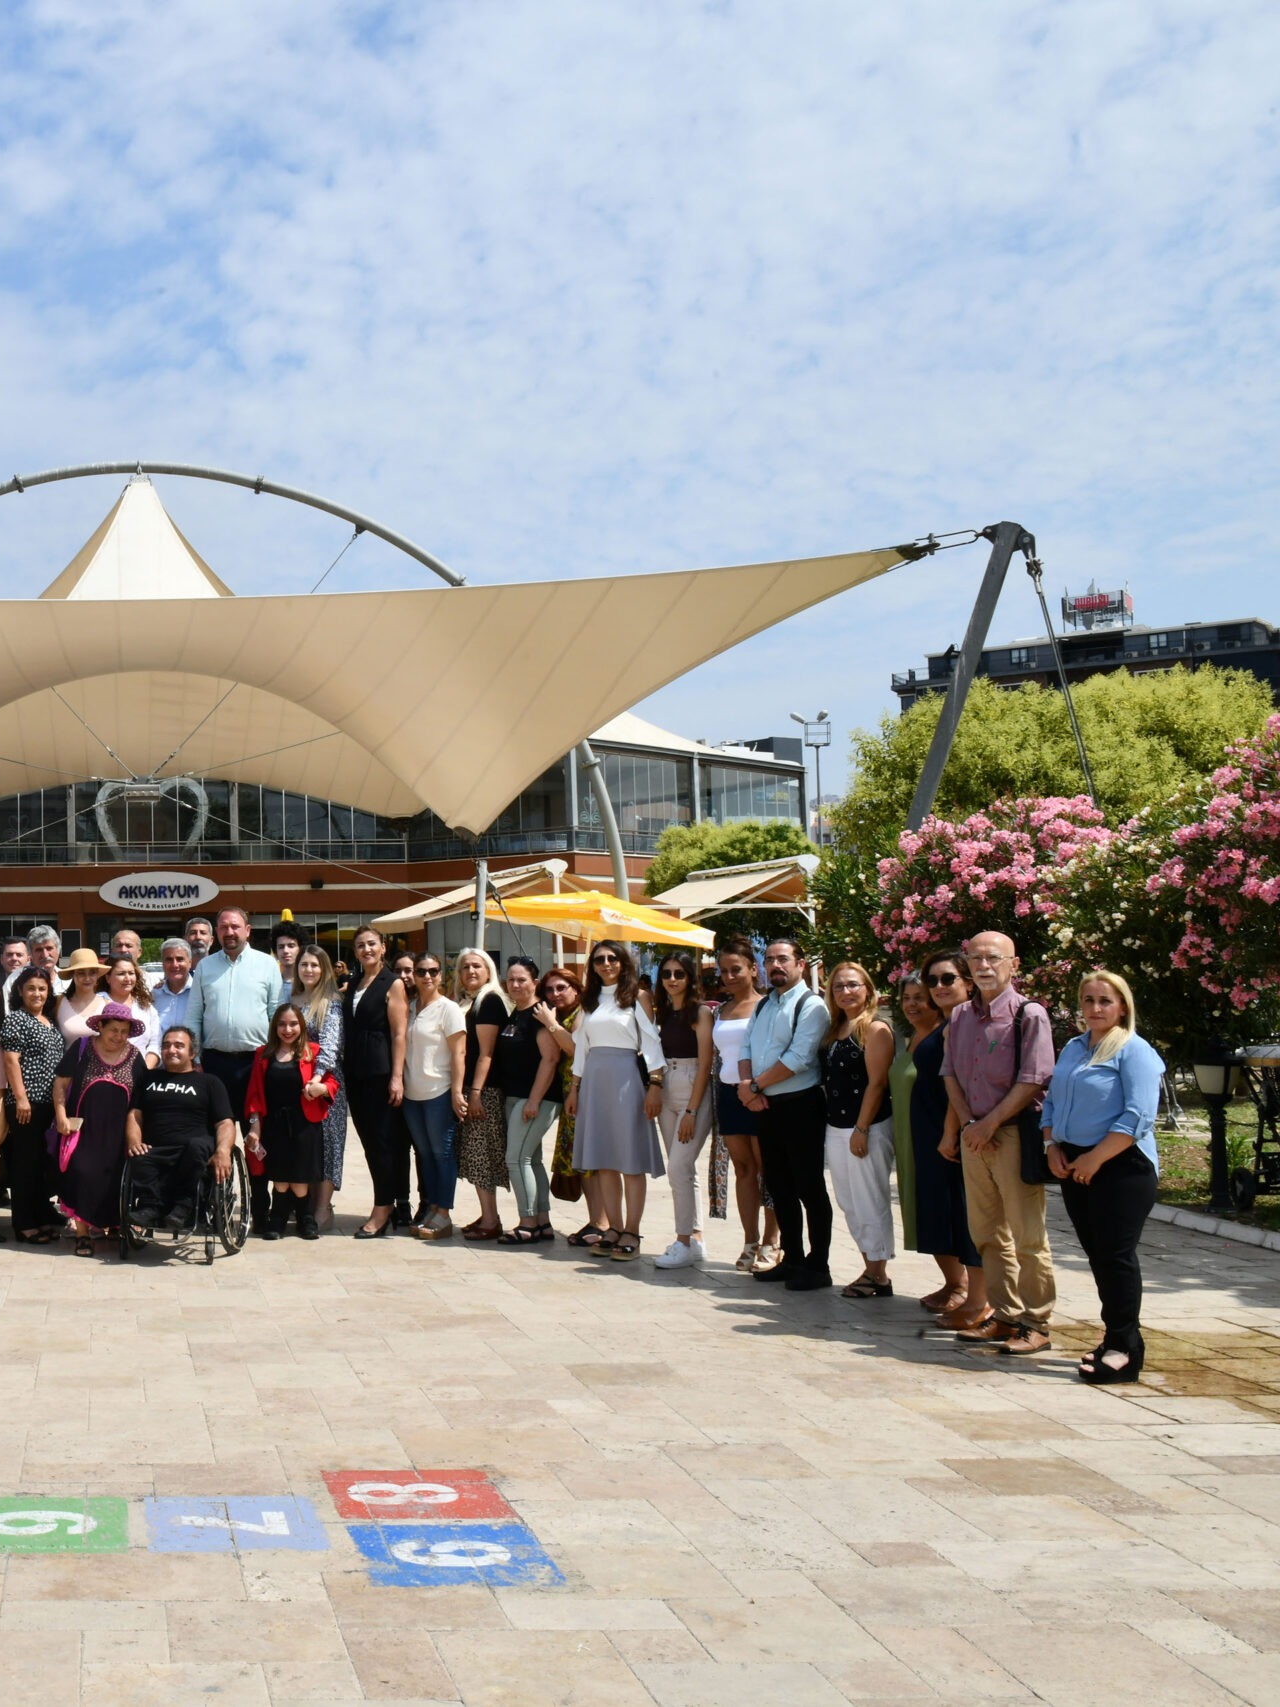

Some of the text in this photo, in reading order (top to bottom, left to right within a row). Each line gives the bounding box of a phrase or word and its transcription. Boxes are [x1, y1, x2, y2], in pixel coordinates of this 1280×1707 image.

[118, 884, 199, 899] AKVARYUM
[128, 900, 144, 909] Cafe
[151, 900, 191, 910] Restaurant
[146, 1081, 197, 1096] ALPHA
[347, 1483, 459, 1505] 8
[180, 1511, 290, 1535] 7
[391, 1540, 512, 1567] 9
